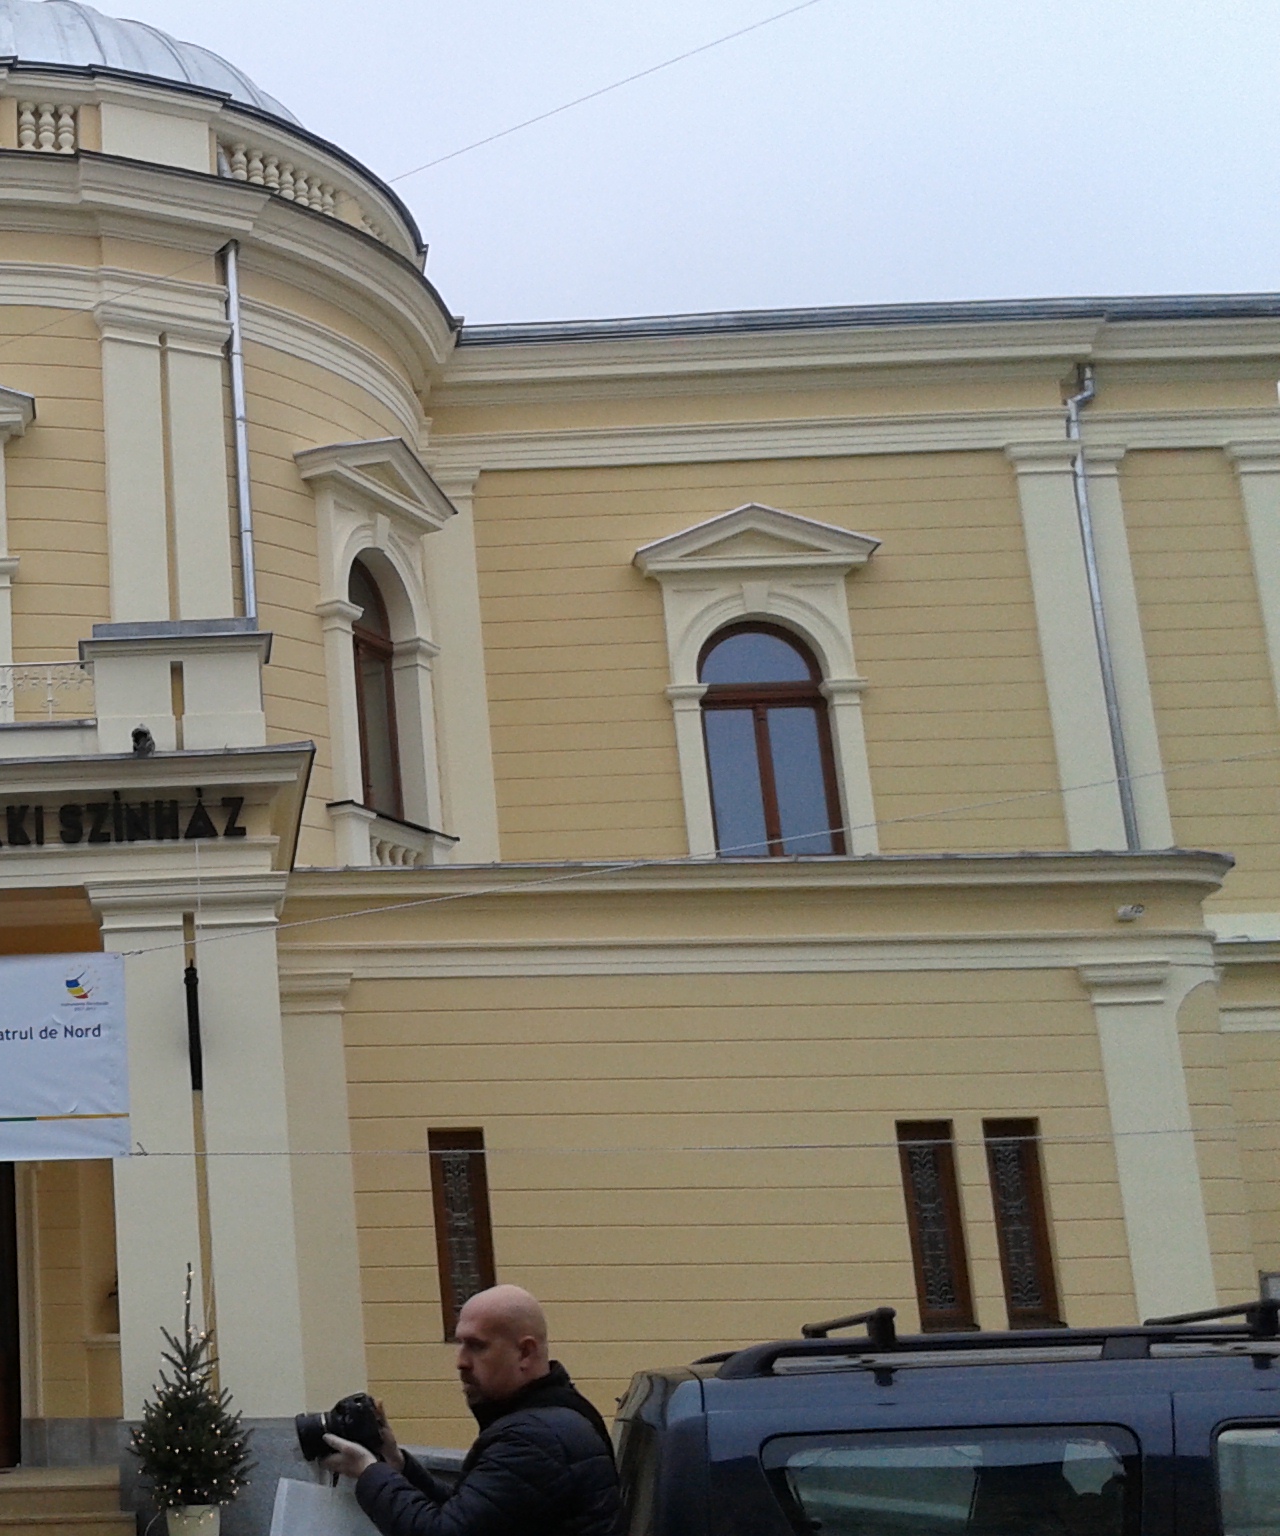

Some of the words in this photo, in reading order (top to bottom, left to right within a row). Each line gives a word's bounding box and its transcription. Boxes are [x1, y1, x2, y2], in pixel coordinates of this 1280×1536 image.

[59, 787, 247, 844] SZÍNHÁZ
[39, 1025, 58, 1039] de
[64, 1024, 101, 1038] Nord
